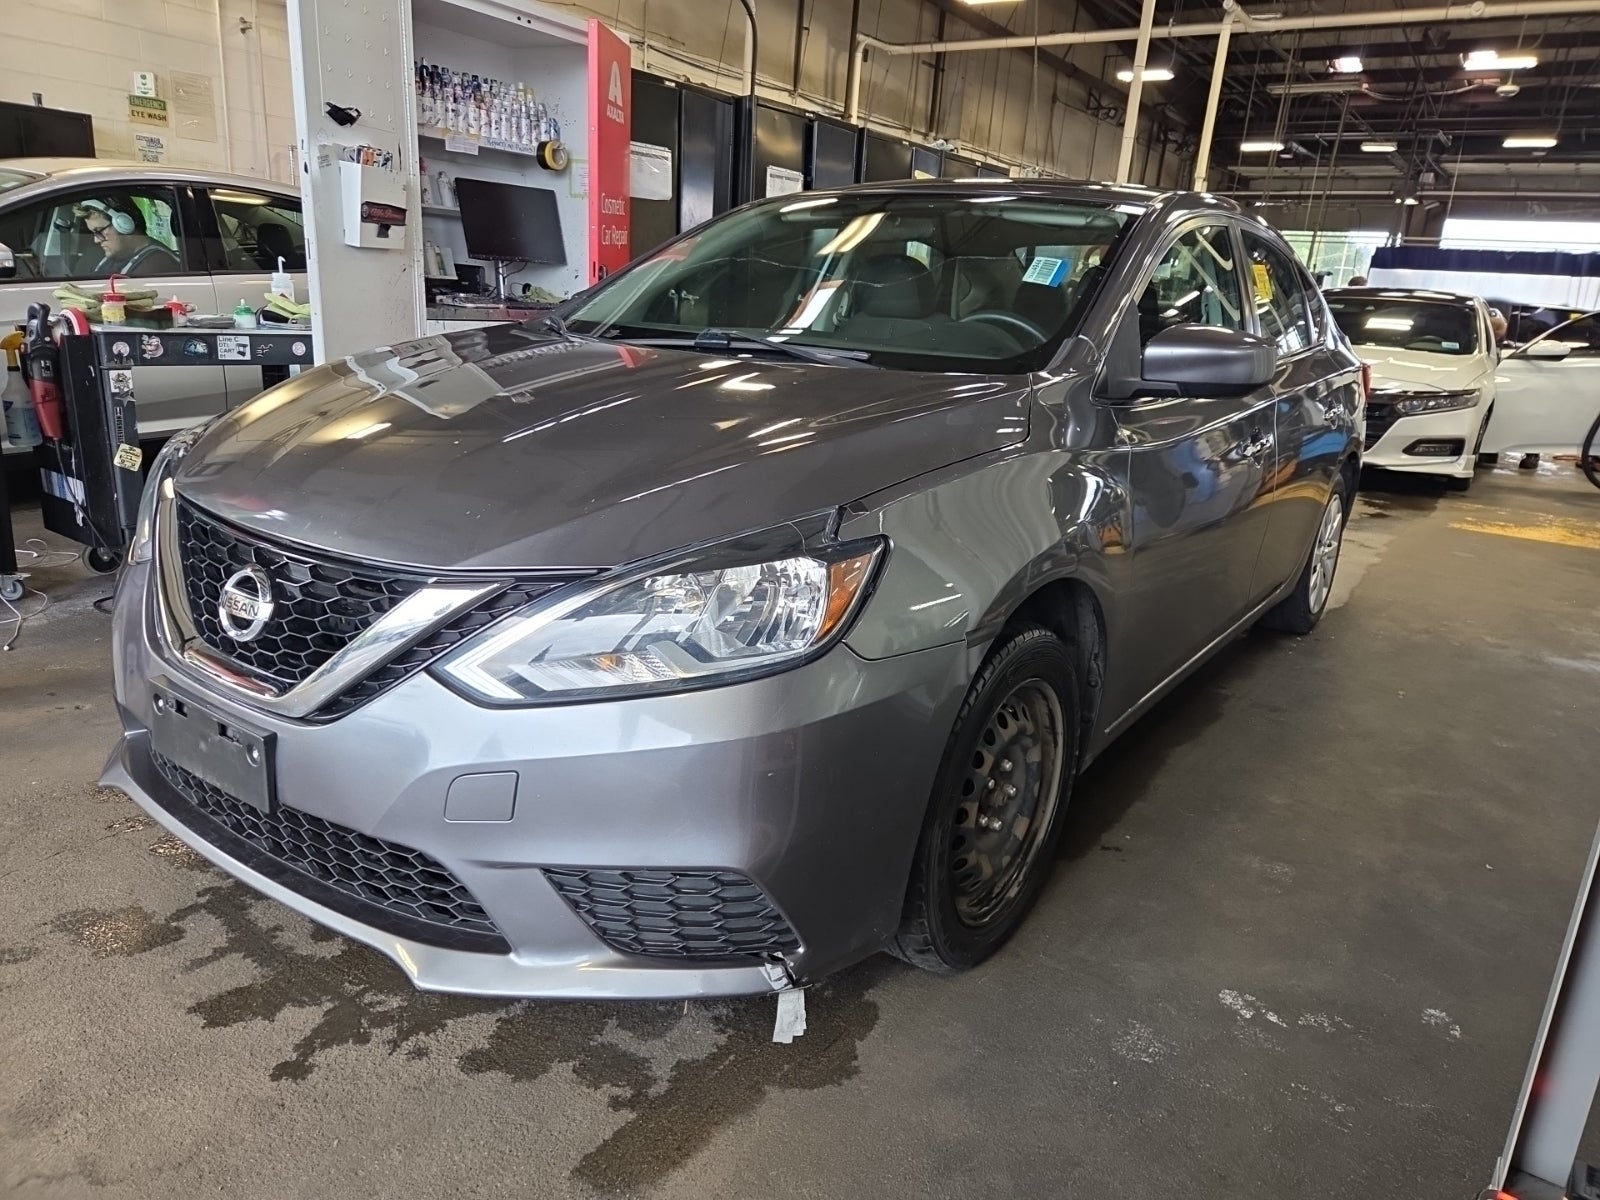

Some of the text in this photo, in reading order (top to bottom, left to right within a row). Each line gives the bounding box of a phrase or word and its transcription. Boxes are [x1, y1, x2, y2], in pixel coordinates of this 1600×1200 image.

[130, 96, 166, 110] EMERGENCY
[606, 103, 625, 125] AXALTA
[131, 109, 167, 122] EYE WASH
[601, 192, 626, 216] Cosmetic
[601, 224, 628, 250] Car Repair
[220, 592, 260, 617] NISSAN
